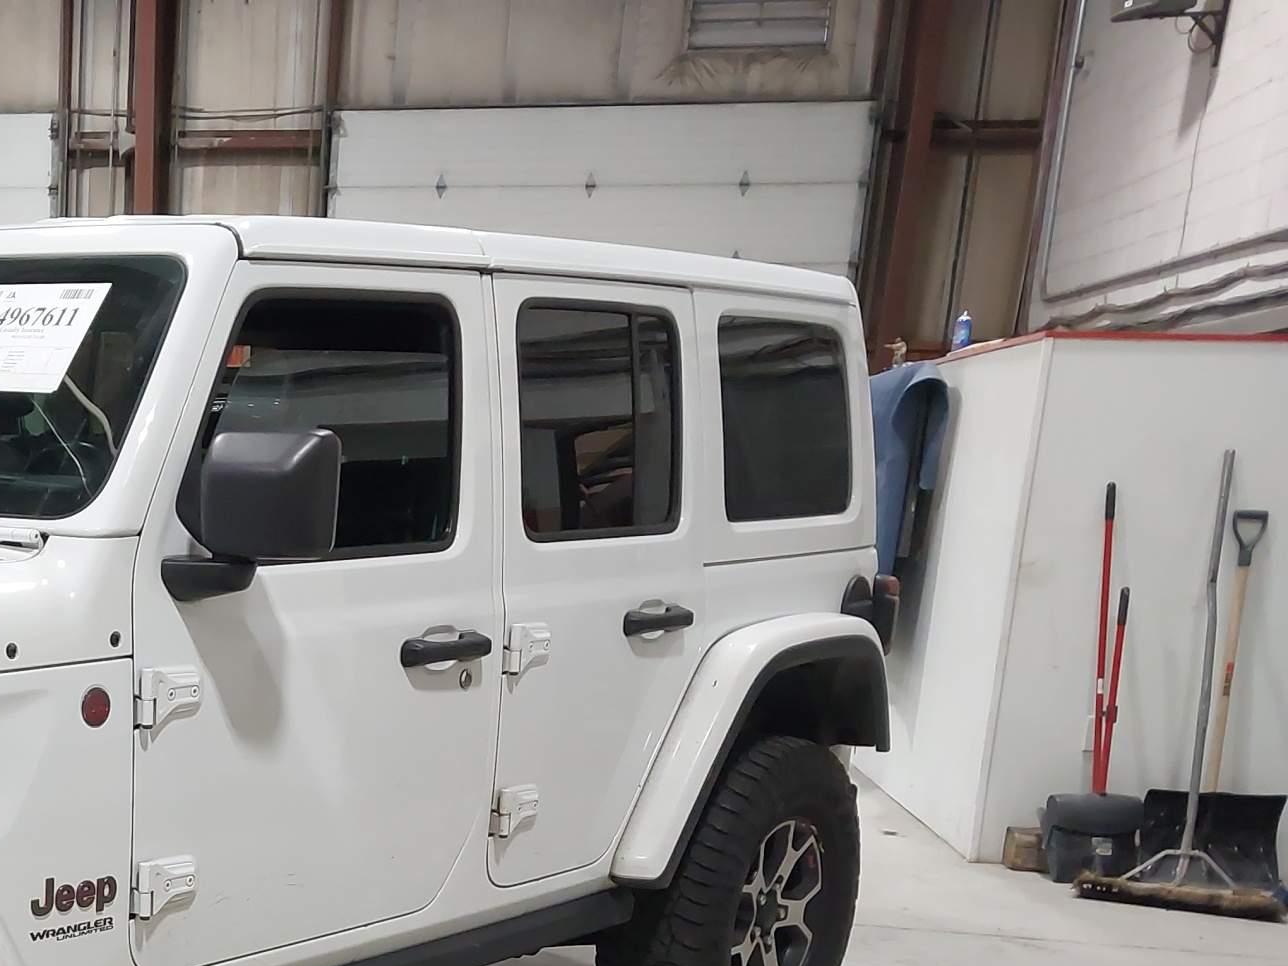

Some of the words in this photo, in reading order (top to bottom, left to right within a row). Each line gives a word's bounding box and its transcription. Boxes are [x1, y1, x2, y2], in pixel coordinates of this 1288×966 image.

[30, 875, 117, 917] Jeep
[29, 916, 114, 942] WRANGLER
[56, 925, 114, 942] UNLIMITED
